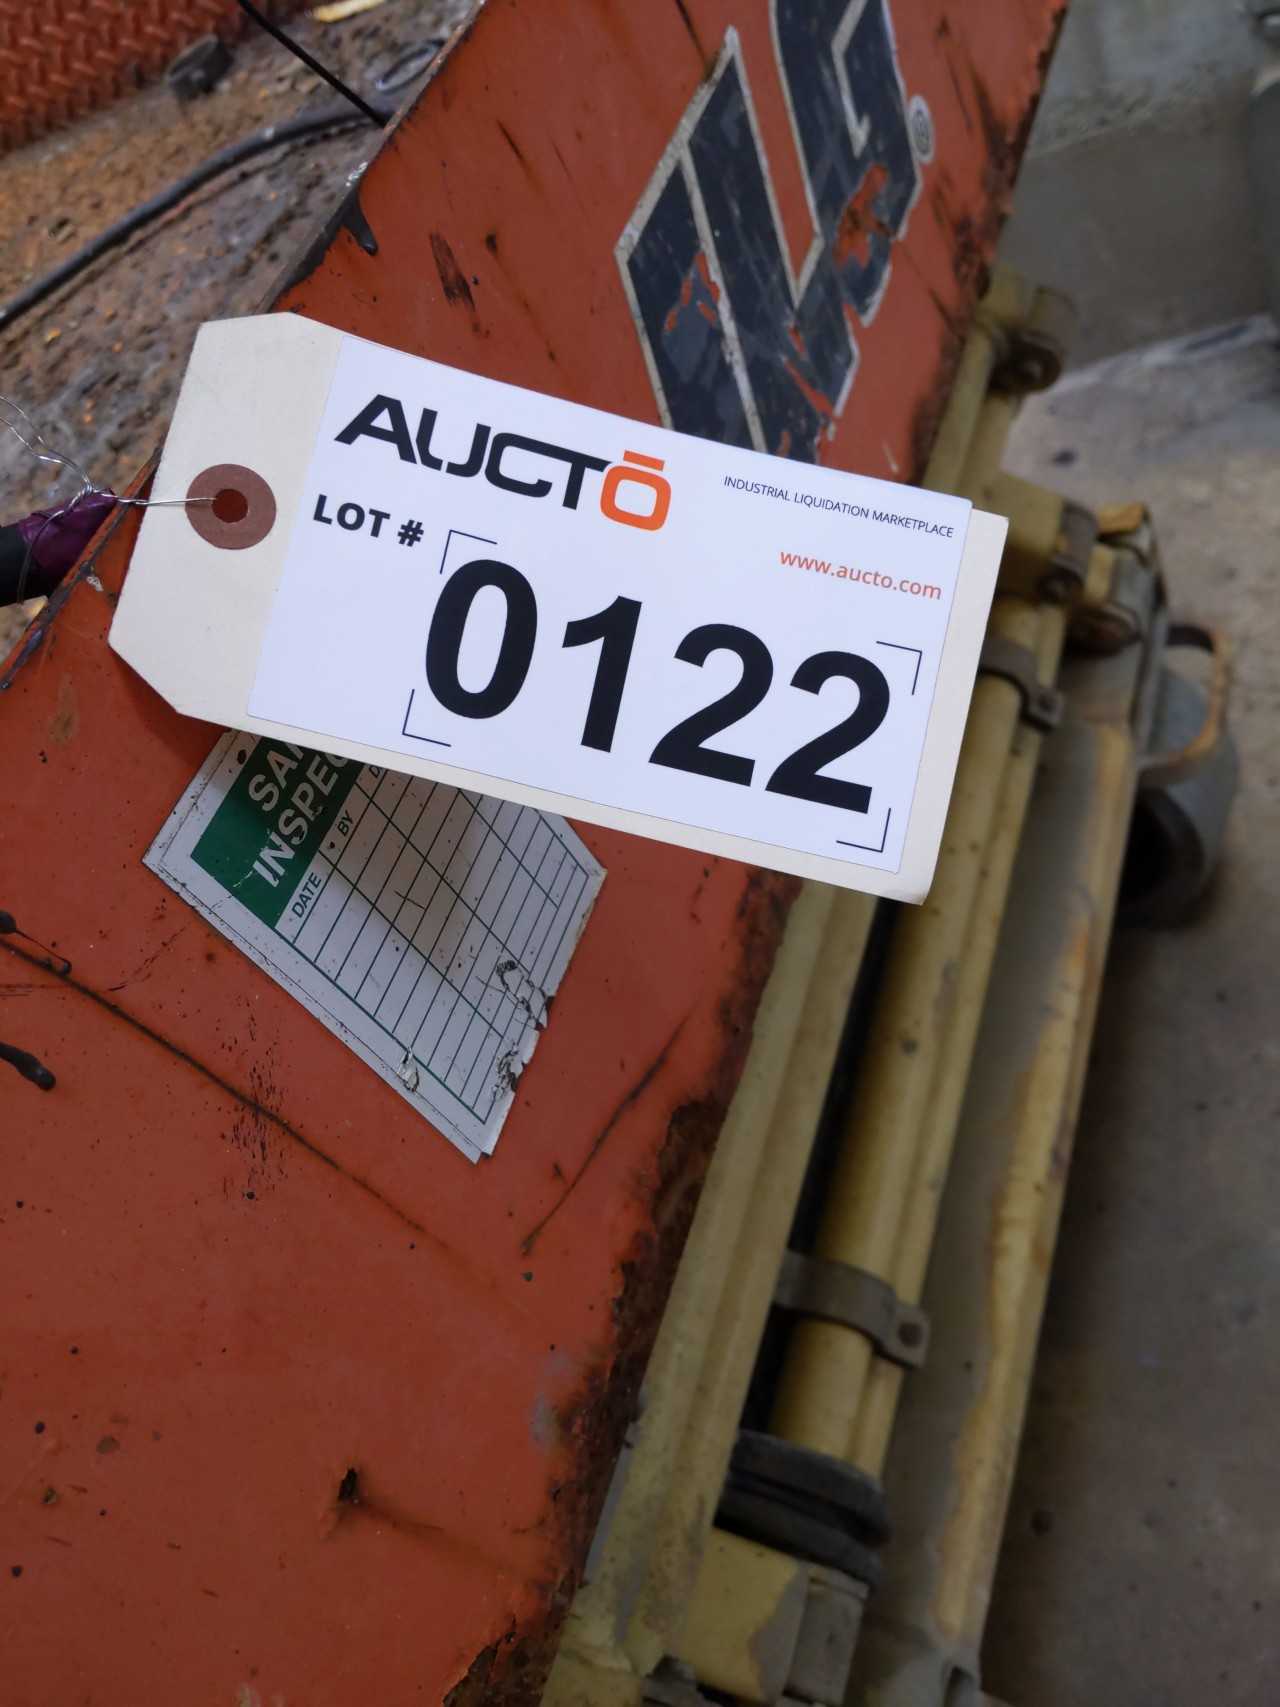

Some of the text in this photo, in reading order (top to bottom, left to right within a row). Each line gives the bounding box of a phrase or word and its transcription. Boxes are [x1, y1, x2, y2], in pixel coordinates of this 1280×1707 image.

[313, 494, 424, 548] LOT #
[724, 475, 954, 538] INDUSTRIAL LIQUIDATION MARKETPLACE
[780, 550, 942, 600] www.aucto.com
[425, 558, 891, 814] 0122
[291, 809, 354, 918] DATE BY
